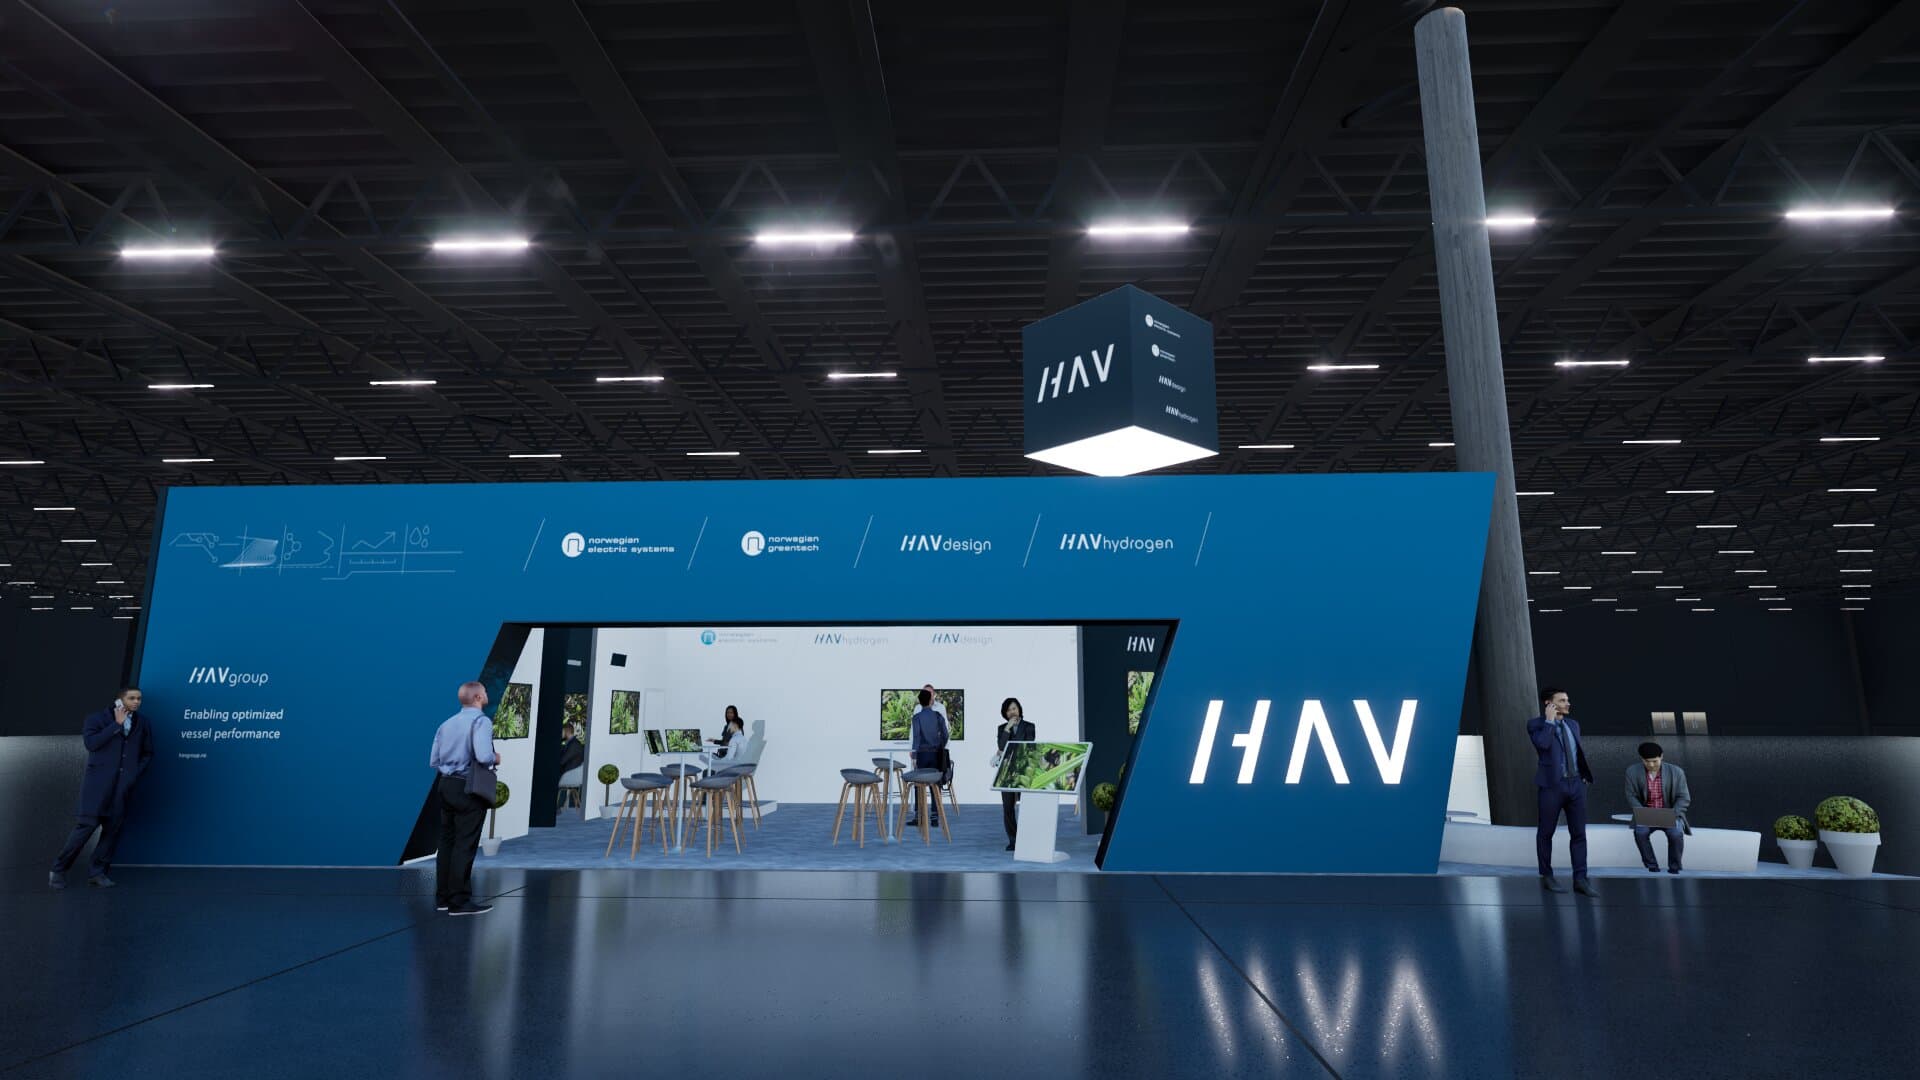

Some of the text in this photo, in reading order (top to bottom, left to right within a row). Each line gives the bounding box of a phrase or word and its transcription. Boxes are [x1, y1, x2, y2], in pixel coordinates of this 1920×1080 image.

[1037, 343, 1115, 403] HAV
[588, 536, 640, 545] norwegian
[768, 536, 819, 544] norwegian
[631, 546, 675, 554] systems
[768, 545, 819, 553] greentech
[1127, 636, 1155, 653] HAV
[184, 708, 284, 722] Enabling optimized
[181, 728, 281, 741] vessel performance
[1189, 699, 1418, 785] HAV
